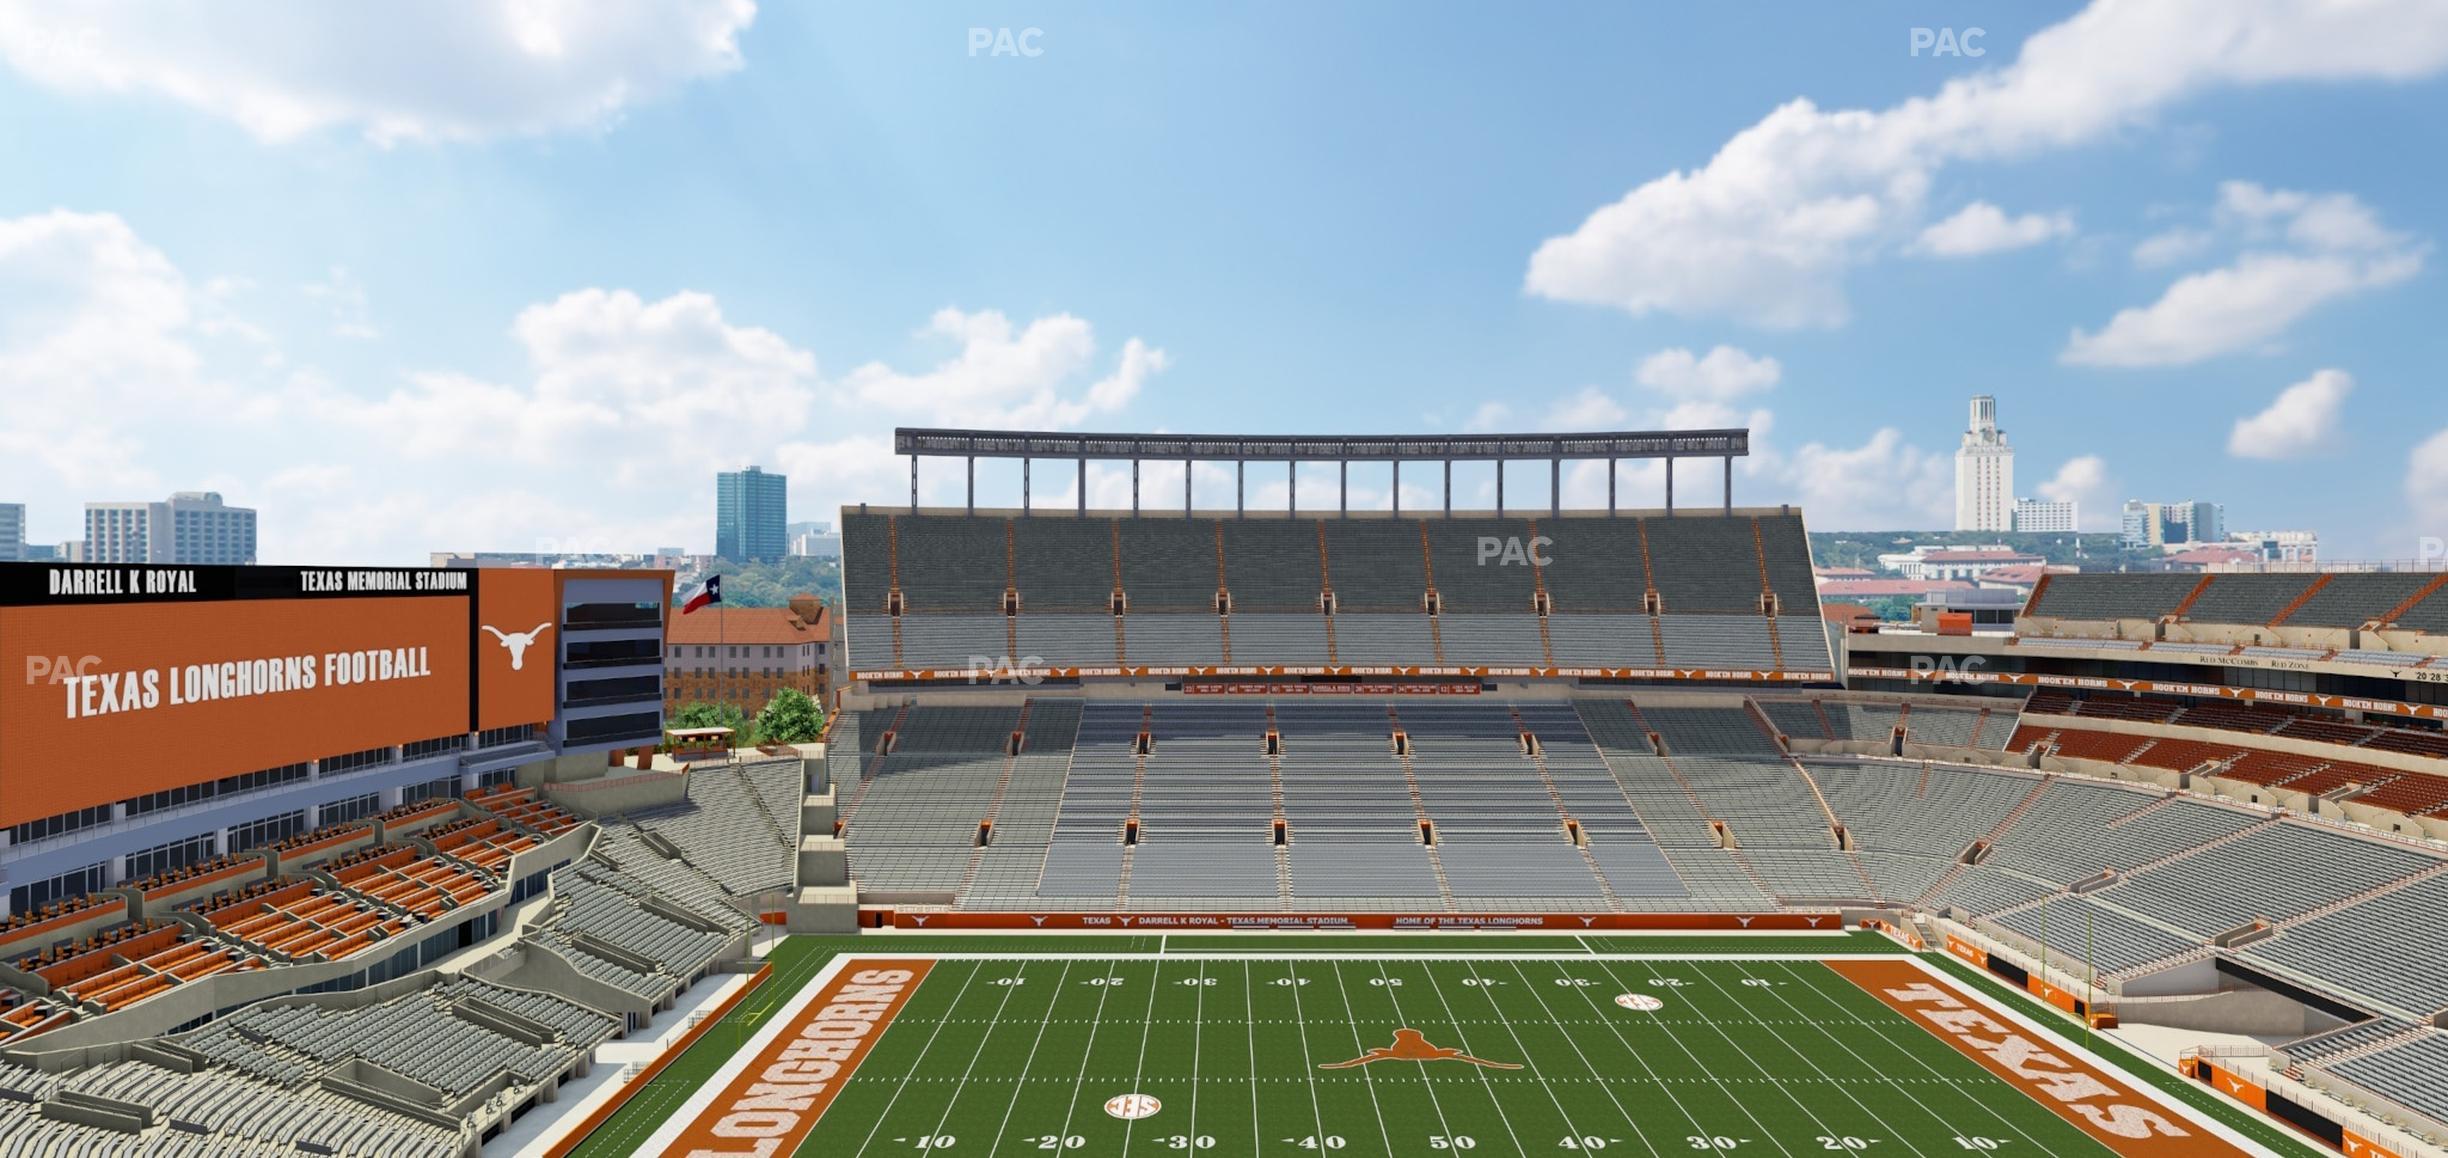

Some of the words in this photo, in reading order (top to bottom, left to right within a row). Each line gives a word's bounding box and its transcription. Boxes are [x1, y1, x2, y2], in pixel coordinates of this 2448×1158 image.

[49, 567, 123, 595] DARRELL
[128, 568, 140, 594] K
[145, 568, 197, 594] ROYAL
[301, 571, 344, 592] TEXAS
[348, 571, 411, 591] MEMORIAL
[415, 571, 467, 590] STADIUM
[1881, 669, 1906, 677] HORNS
[1975, 673, 1998, 682] HORNS
[2416, 671, 2427, 681] 20
[2431, 673, 2442, 682] 28
[63, 669, 160, 719] TEXAS
[170, 655, 316, 705] LONGHORNS
[325, 646, 431, 687] FOOTBALL
[2038, 676, 2075, 686] HOOK'EM
[2077, 678, 2107, 688] HORNS
[2152, 683, 2188, 693] HOOK'EM
[2191, 685, 2219, 696] HORNS
[2255, 690, 2283, 701] HOOK'EM
[2284, 693, 2307, 703] HORNS
[2342, 698, 2371, 710] HOOK'EM
[2373, 701, 2396, 712] HORNS
[1082, 916, 1111, 925] TEXAS
[1138, 916, 1179, 925] DARRELL
[1180, 916, 1188, 925] K
[1188, 916, 1219, 925] ROYAL
[1227, 916, 1255, 925] TEXAS
[1257, 916, 1304, 925] MEMORIAL
[1306, 916, 1349, 925] STADIUM
[1395, 916, 1422, 925] HOME
[1423, 916, 1436, 925] OF
[1438, 916, 1456, 925] THE
[1457, 916, 1486, 925] TEXAS
[1487, 916, 1544, 925] LONGHORNS
[685, 969, 914, 1158] LONGHORNS
[1883, 983, 2191, 1138] TEXAS
[914, 1135, 956, 1149] 10
[1038, 1135, 1086, 1149] 20
[1168, 1135, 1216, 1149] 30
[1298, 1135, 1346, 1149] 40
[1429, 1135, 1476, 1149] 50
[1558, 1135, 1606, 1149] 40
[1686, 1135, 1737, 1149] 30
[1816, 1135, 1867, 1149] 20
[1952, 1135, 1998, 1149] 10
